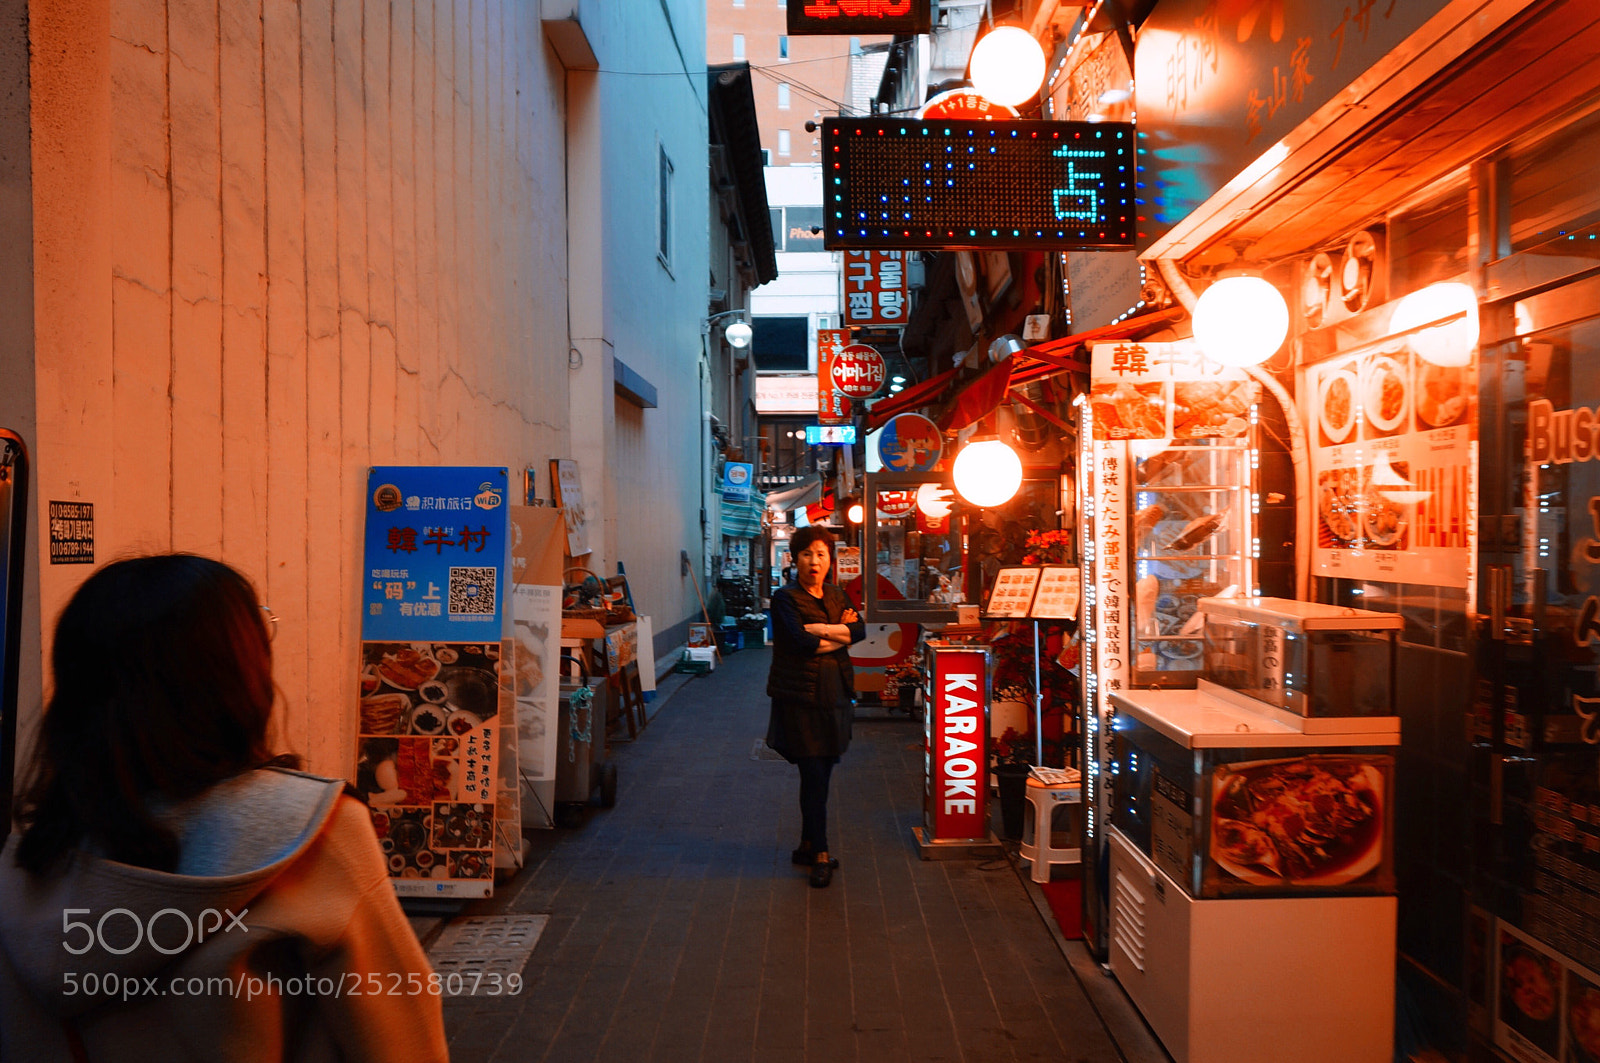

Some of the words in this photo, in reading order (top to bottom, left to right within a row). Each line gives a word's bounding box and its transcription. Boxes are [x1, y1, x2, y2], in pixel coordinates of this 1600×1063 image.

[833, 362, 883, 383] 어머니집
[422, 496, 472, 511] 积木旅行
[386, 525, 490, 554] 韓牛村
[400, 602, 442, 616] 有优惠
[944, 673, 978, 815] KARAOKE
